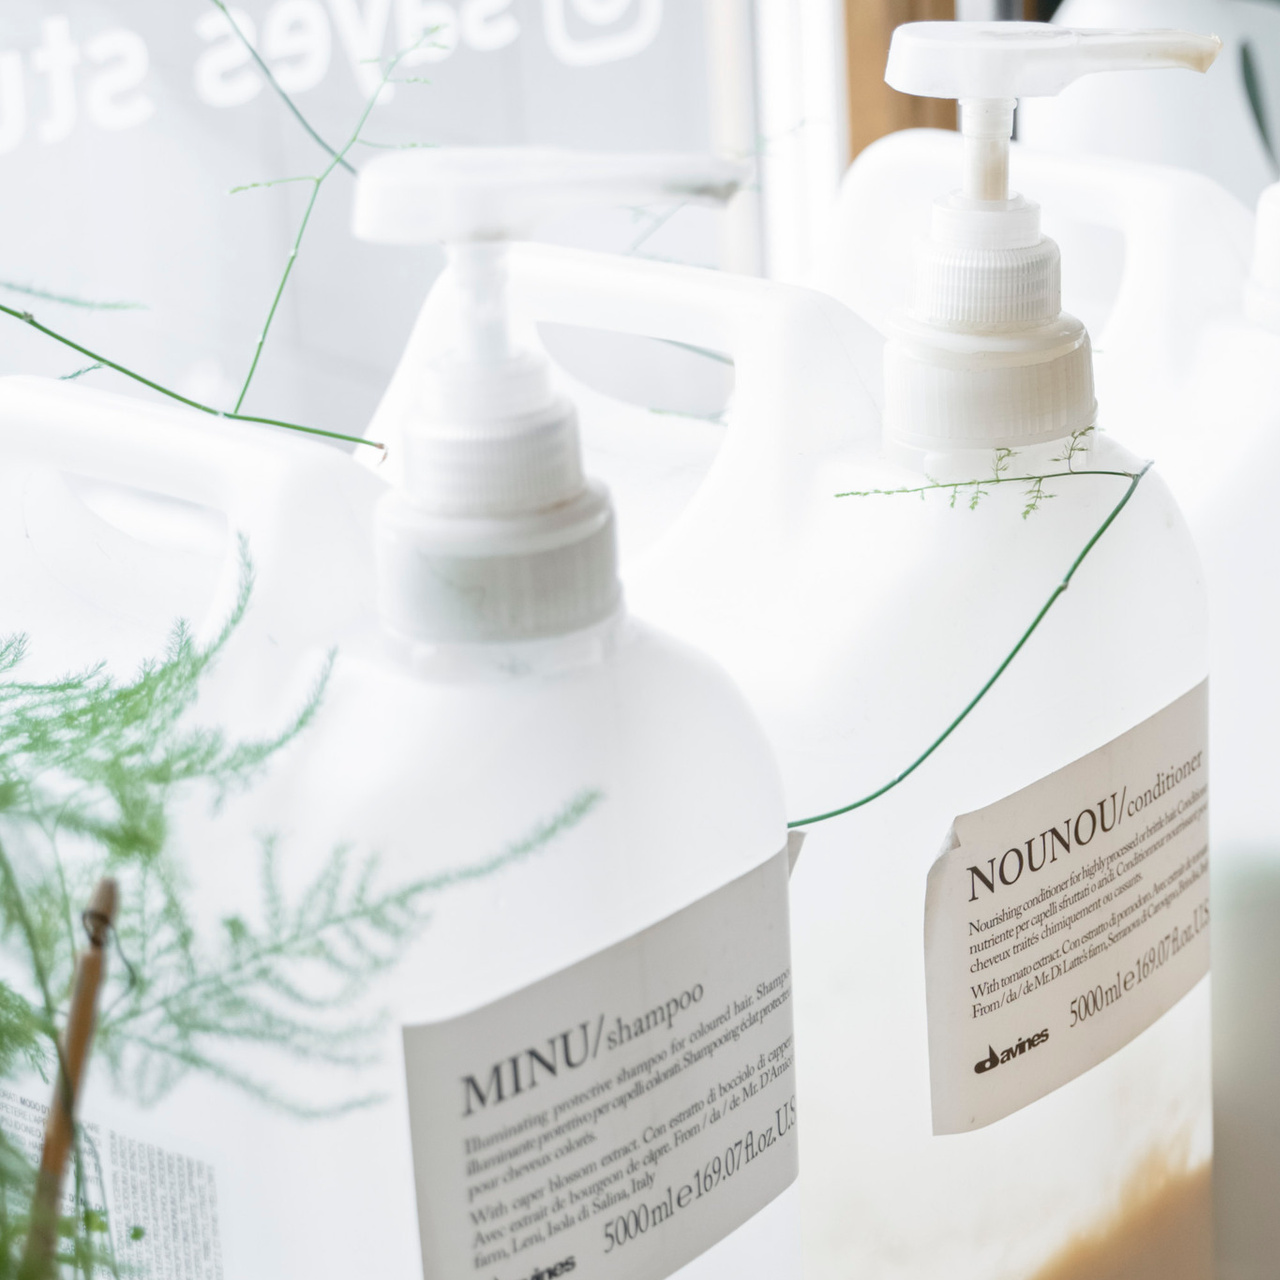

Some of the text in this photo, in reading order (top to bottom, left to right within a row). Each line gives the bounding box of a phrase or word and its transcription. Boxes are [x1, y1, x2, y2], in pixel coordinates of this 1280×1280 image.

[969, 905, 1023, 937] Nourishing
[1023, 878, 1069, 912] conditioner
[1069, 870, 1082, 888] for
[969, 927, 1015, 955] nutriente
[1014, 921, 1031, 939] per
[1031, 903, 1058, 928] capelli
[1058, 886, 1091, 914] sfruttati
[970, 949, 1011, 974] cheveux
[1040, 897, 1102, 942] chimiquement
[970, 978, 1000, 1000] With
[1000, 966, 1033, 990] tomato
[972, 998, 1001, 1020] From
[552, 1076, 613, 1121] protective
[616, 1049, 668, 1084] shampoo
[669, 1035, 686, 1057] for
[688, 1005, 732, 1044] coloured
[974, 1027, 1050, 1074] davines
[467, 1176, 500, 1203] pour
[502, 1155, 553, 1184] cheveux
[470, 1200, 509, 1226] With
[511, 1185, 545, 1210] caper
[547, 1161, 598, 1193] blossom
[642, 1123, 667, 1144] Con
[474, 1225, 507, 1250] Avec
[673, 1124, 701, 1149] From
